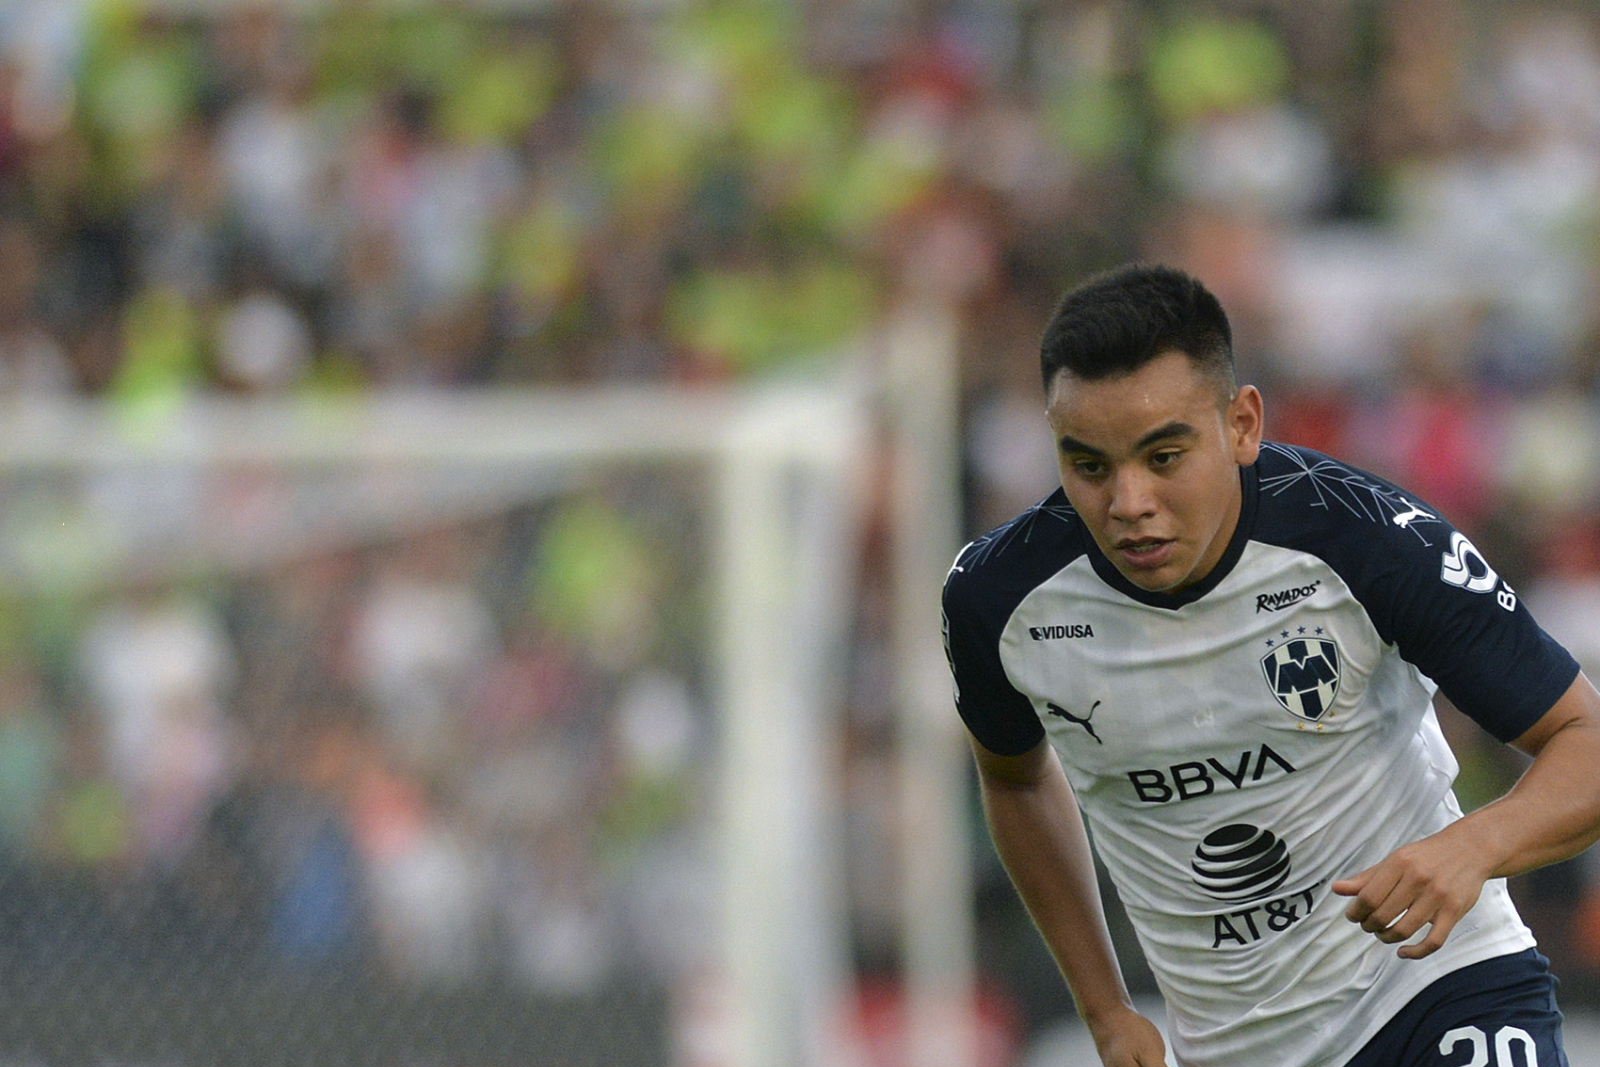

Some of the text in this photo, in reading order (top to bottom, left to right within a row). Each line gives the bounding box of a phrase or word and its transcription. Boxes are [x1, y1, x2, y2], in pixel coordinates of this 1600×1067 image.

[1256, 583, 1318, 614] RAYADOS
[1042, 624, 1094, 640] VIDUSA
[1127, 743, 1297, 803] BBVA
